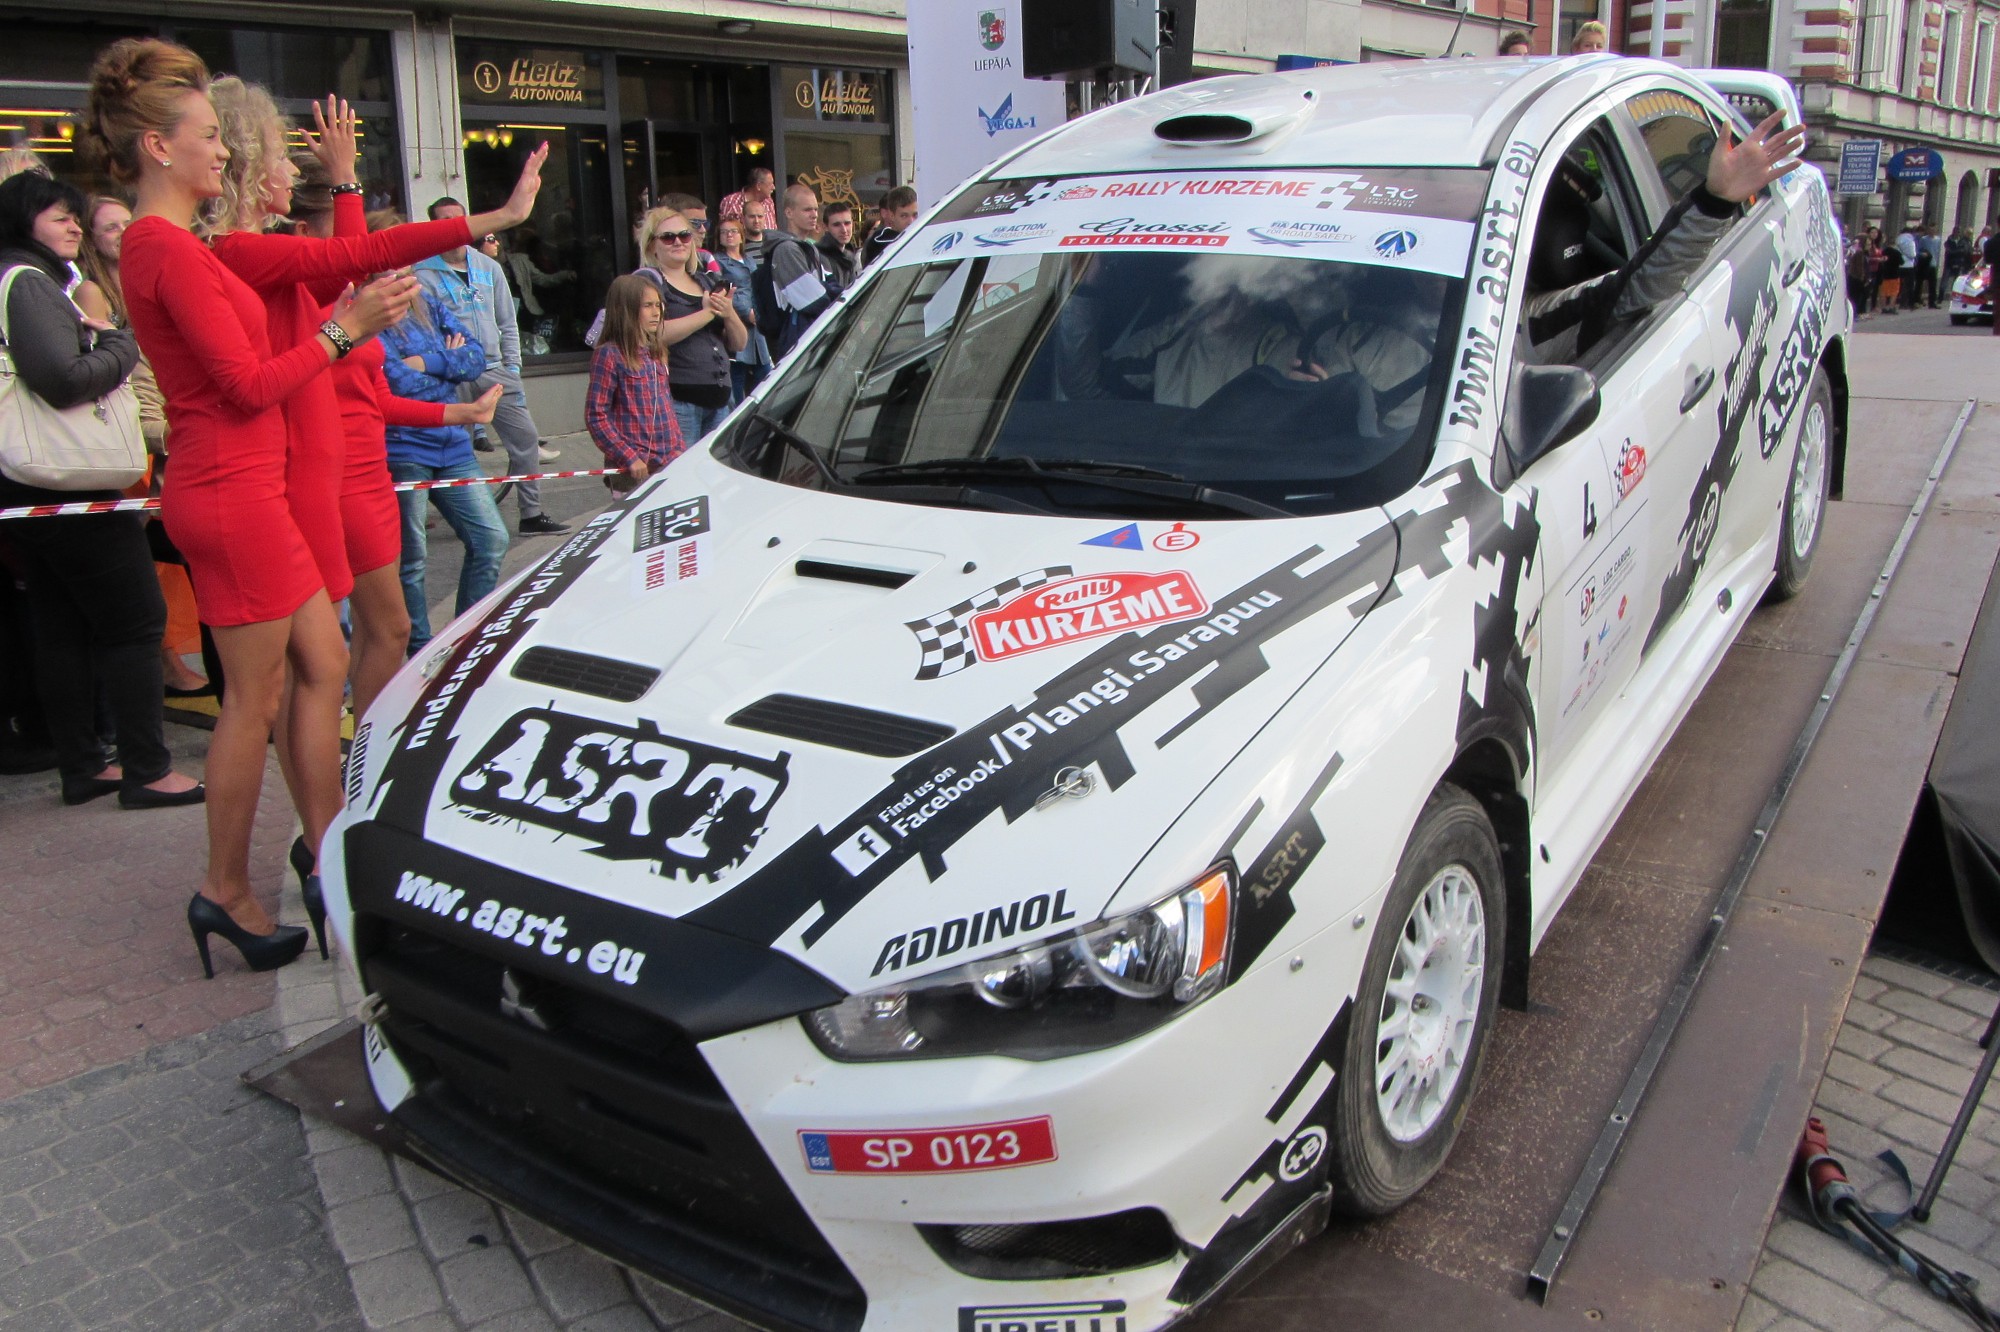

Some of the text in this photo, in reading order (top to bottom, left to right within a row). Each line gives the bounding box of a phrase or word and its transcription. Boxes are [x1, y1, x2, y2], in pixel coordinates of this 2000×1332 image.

[508, 58, 584, 88] Hertz
[974, 57, 1012, 71] LIEPĀJA
[509, 87, 583, 102] AUTONOMA
[821, 103, 875, 116] AUTONOMA
[987, 116, 1036, 131] VEGA-1
[1101, 180, 1316, 198] RALLY KURZEME
[1007, 223, 1047, 232] ACTION
[1067, 236, 1221, 245] TOIDUKAUBAD
[1079, 217, 1233, 237] Grossi
[1283, 230, 1312, 239] ROAD
[1313, 232, 1357, 241] SAFETY
[1289, 222, 1341, 233] ACTION
[1449, 140, 1538, 430] www.asrt.eu
[1584, 481, 1597, 541] 4
[645, 549, 665, 563] TO
[678, 540, 698, 581] THE PLACE
[1041, 579, 1115, 608] Rally
[985, 580, 1194, 655] KURZEME
[460, 718, 780, 858] ASRT
[877, 765, 957, 824] Find us on
[1249, 831, 1308, 909] ASRT
[395, 870, 646, 986] www.asrt.eu
[869, 888, 1076, 979] ADDINOL
[862, 1130, 1021, 1169] SP 0123
